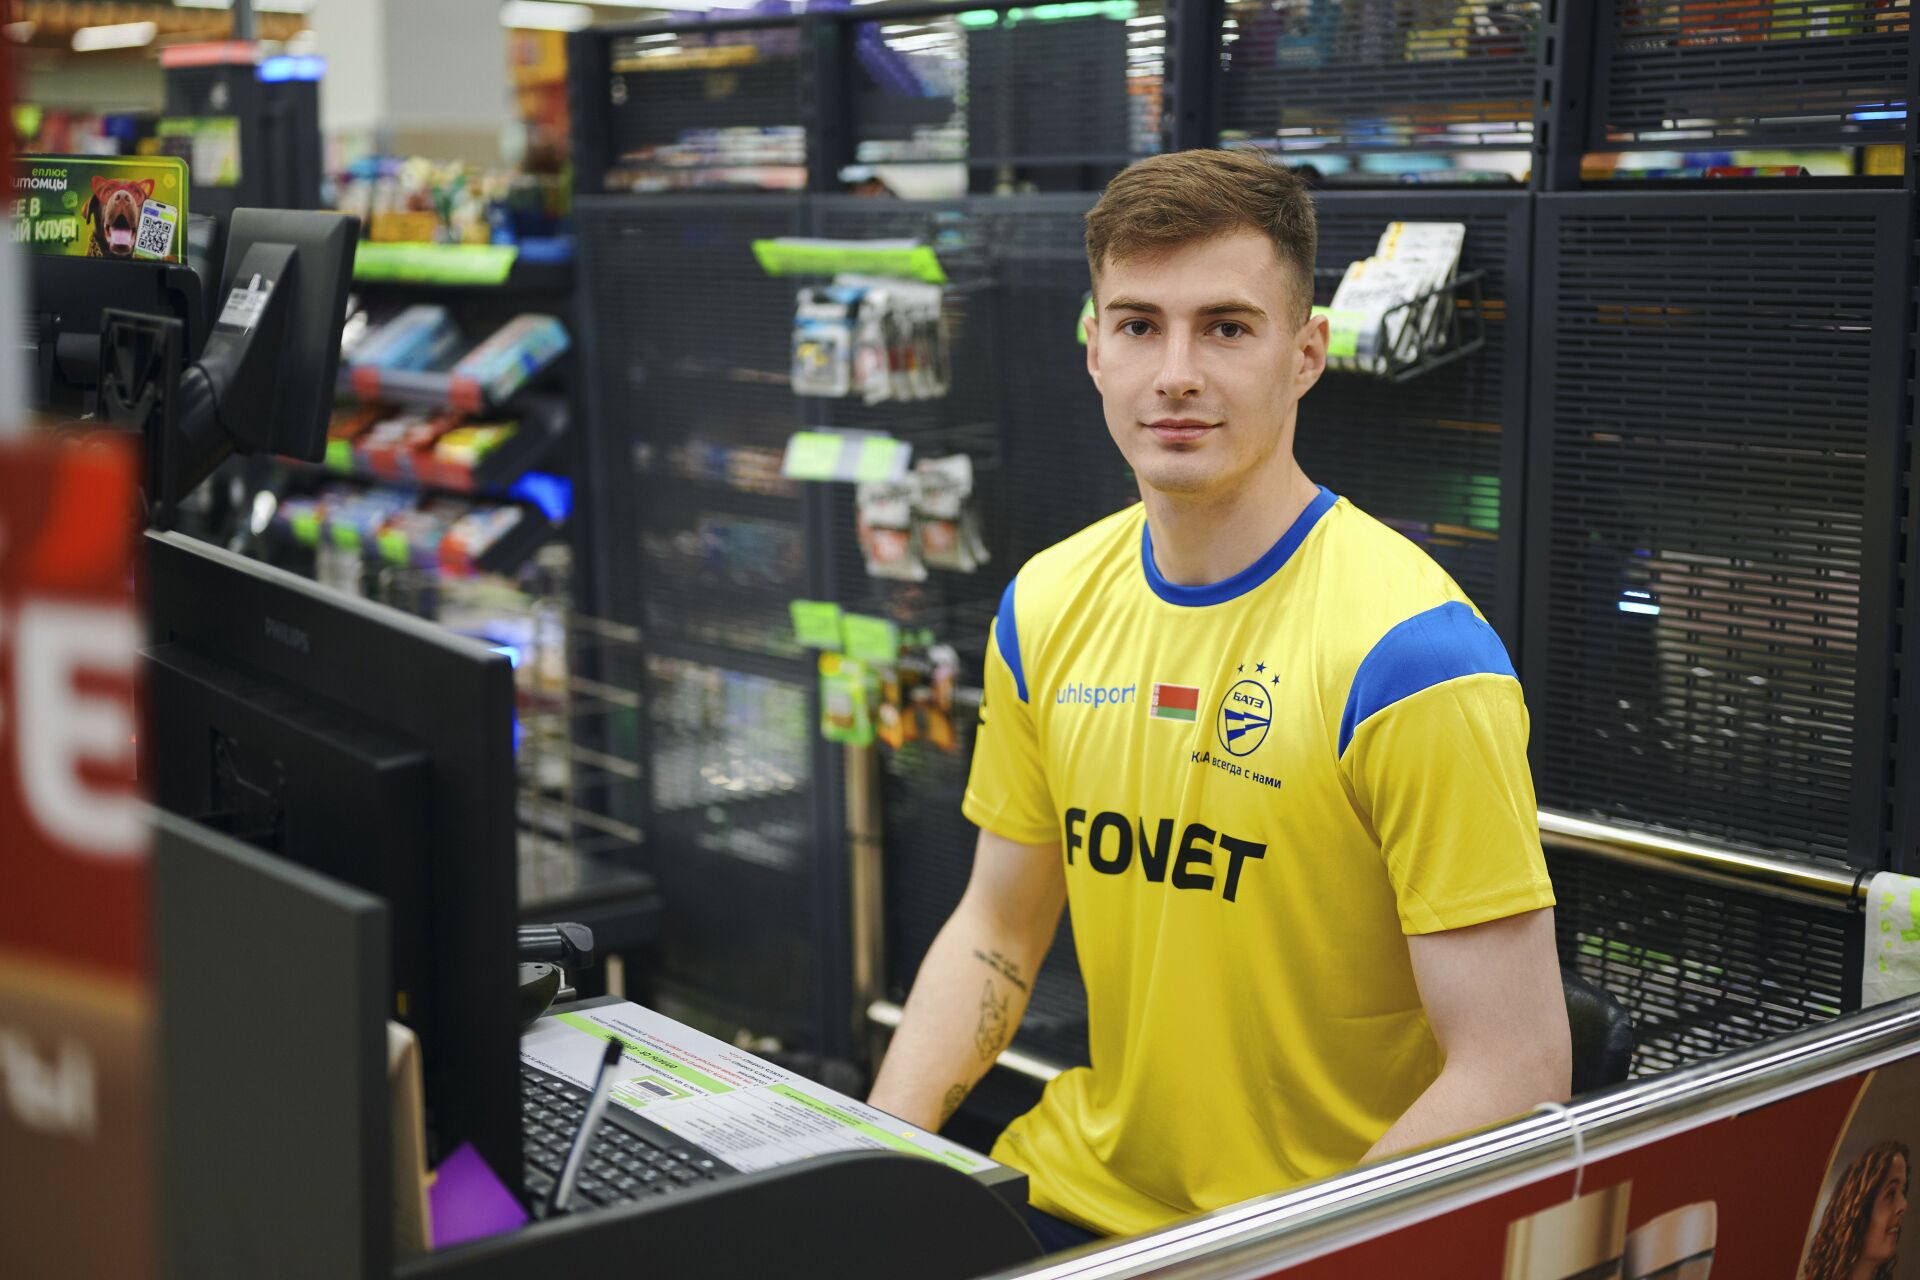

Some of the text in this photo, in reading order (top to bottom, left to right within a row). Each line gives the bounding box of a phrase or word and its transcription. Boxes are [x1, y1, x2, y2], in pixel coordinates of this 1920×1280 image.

[1056, 682, 1136, 709] uhlsport
[1233, 691, 1265, 709] БАТЭ
[1211, 757, 1242, 776] всегда
[1244, 769, 1250, 779] с
[1252, 771, 1282, 789] нами
[1065, 807, 1268, 904] FONET
